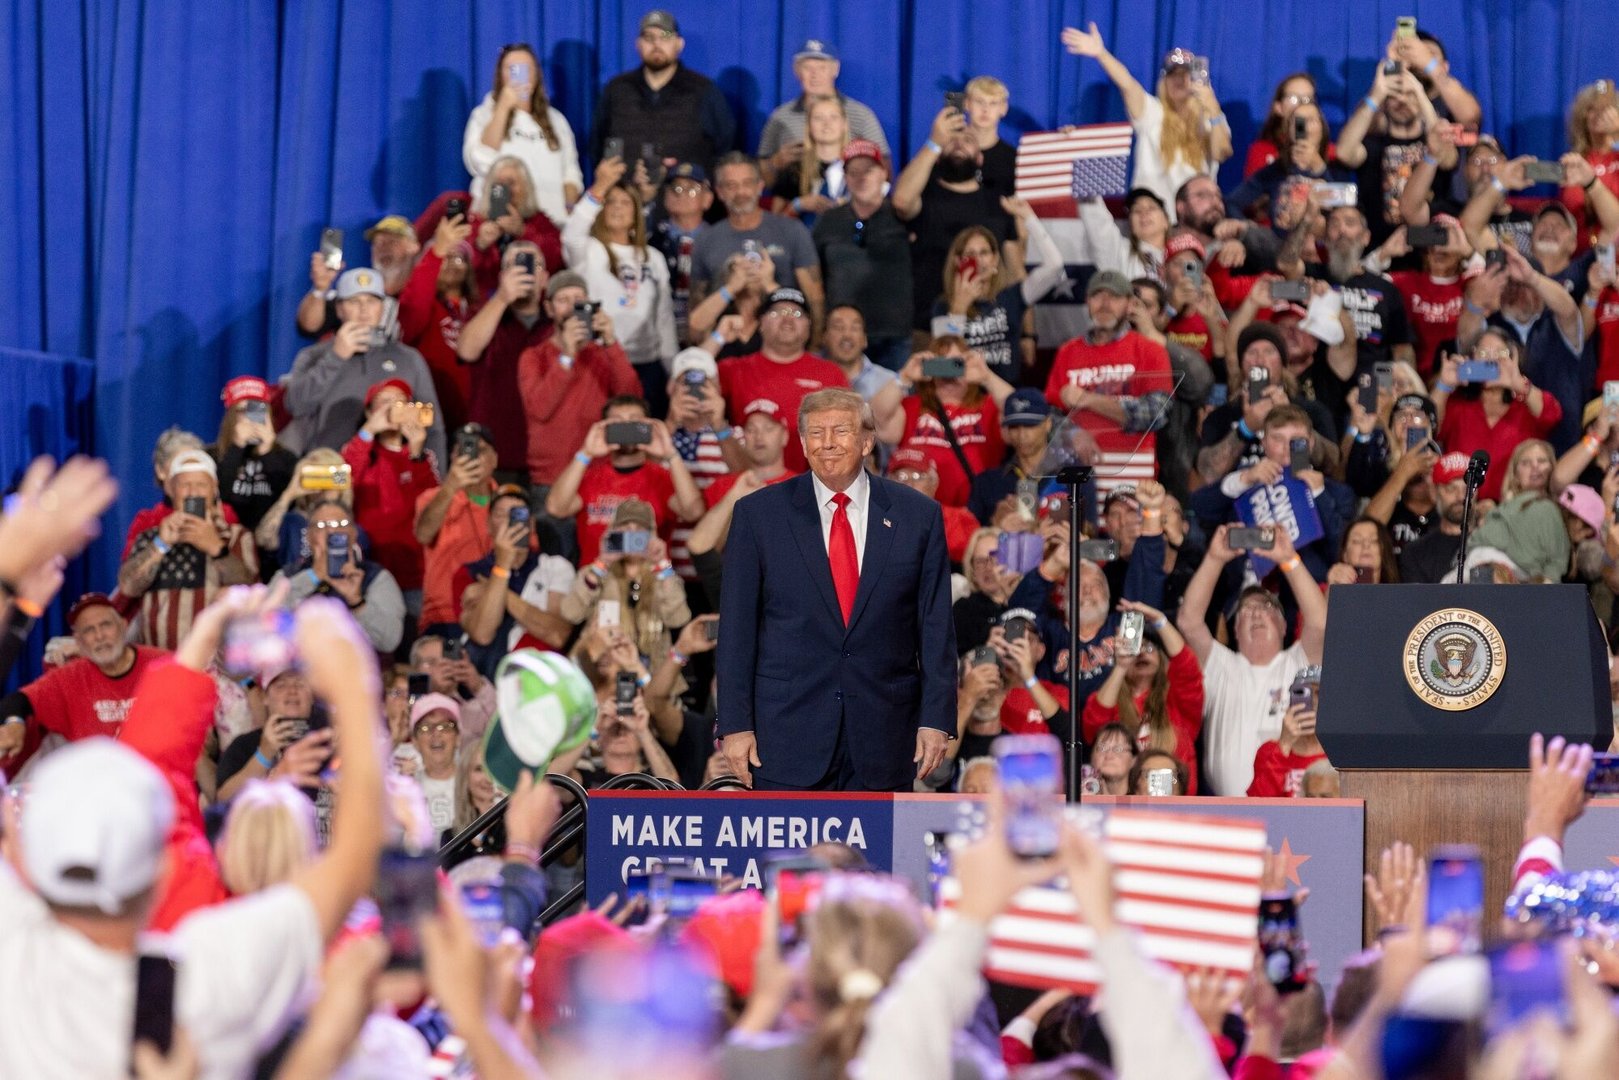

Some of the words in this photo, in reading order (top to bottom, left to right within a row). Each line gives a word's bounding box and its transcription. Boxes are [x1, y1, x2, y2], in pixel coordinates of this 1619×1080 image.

[1067, 363, 1136, 387] TRUMP
[1457, 612, 1467, 621] OF
[1468, 615, 1481, 626] THE
[1407, 611, 1454, 657] PRESIDENT
[1483, 624, 1502, 667] UNITED
[1408, 660, 1417, 674] THE
[1412, 675, 1421, 685] OF
[1464, 675, 1499, 706] STATES
[1420, 683, 1446, 706] SEAL
[612, 815, 703, 846] MAKE
[716, 816, 867, 849] AMERICA
